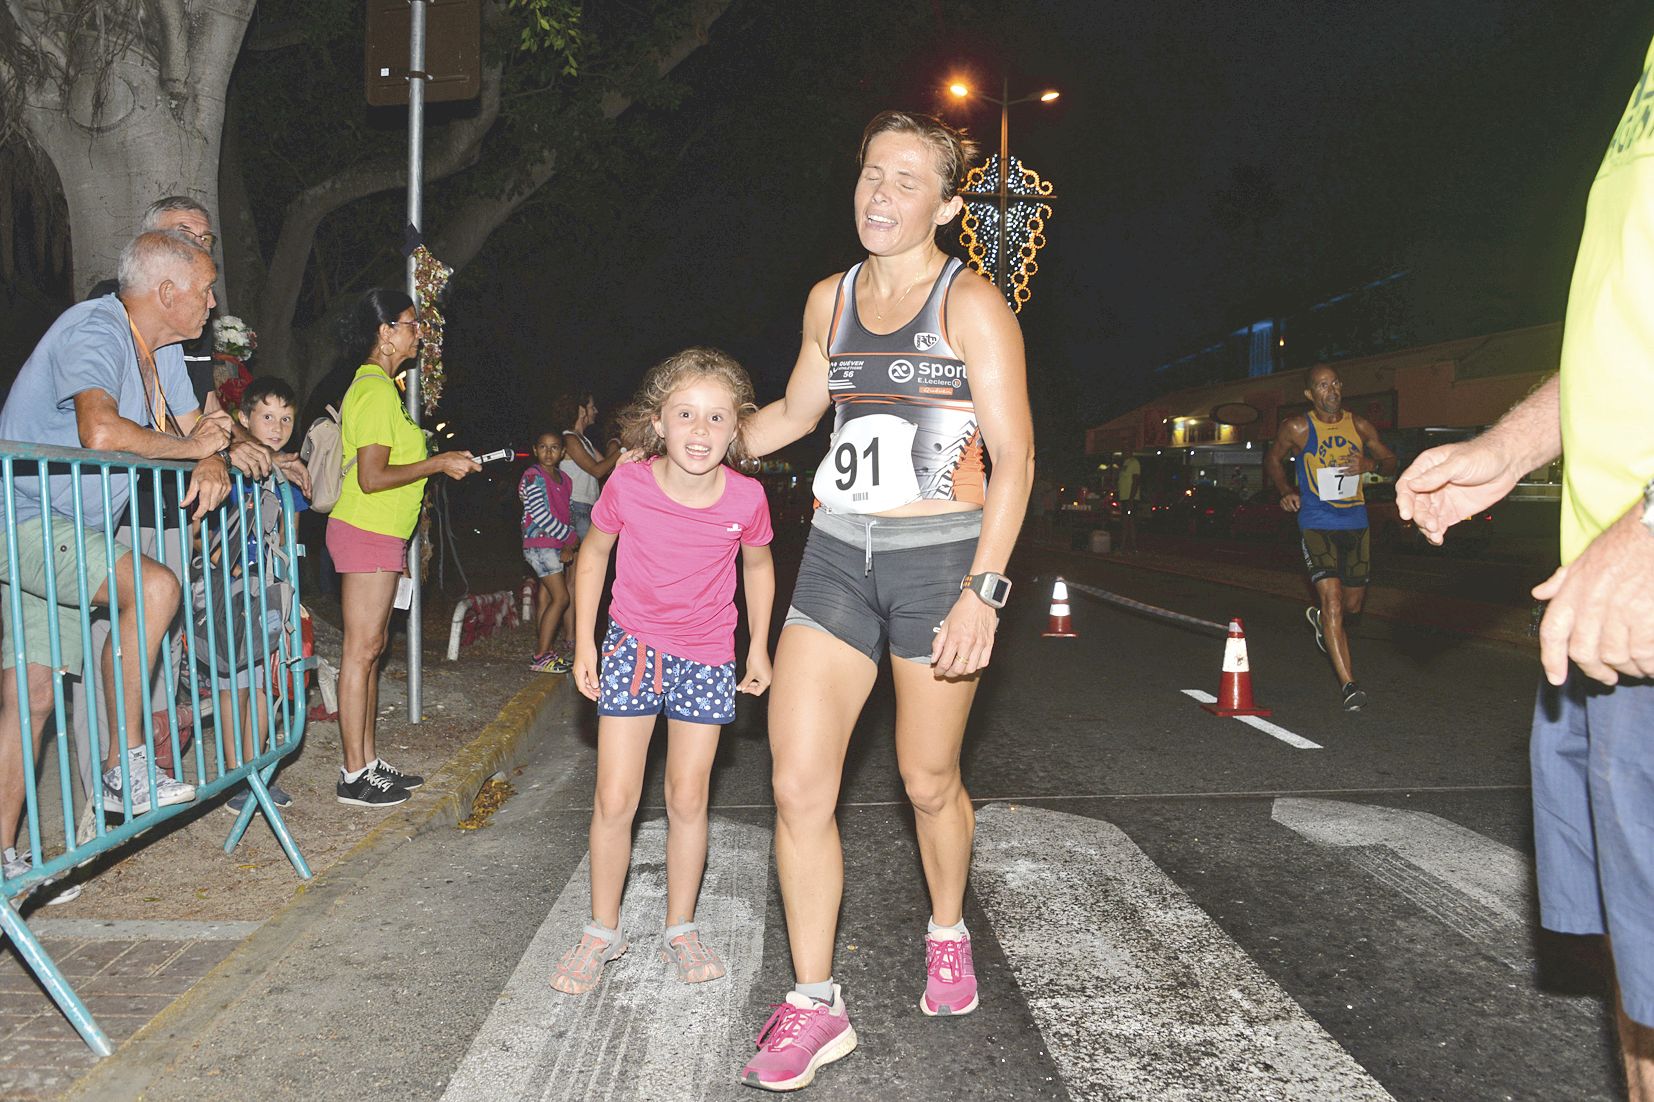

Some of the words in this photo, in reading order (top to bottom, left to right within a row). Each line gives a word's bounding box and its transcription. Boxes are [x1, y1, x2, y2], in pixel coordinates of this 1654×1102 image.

[843, 370, 855, 378] 56
[917, 377, 952, 386] E.Leclerc
[834, 436, 880, 491] 91
[1334, 474, 1345, 491] 7
